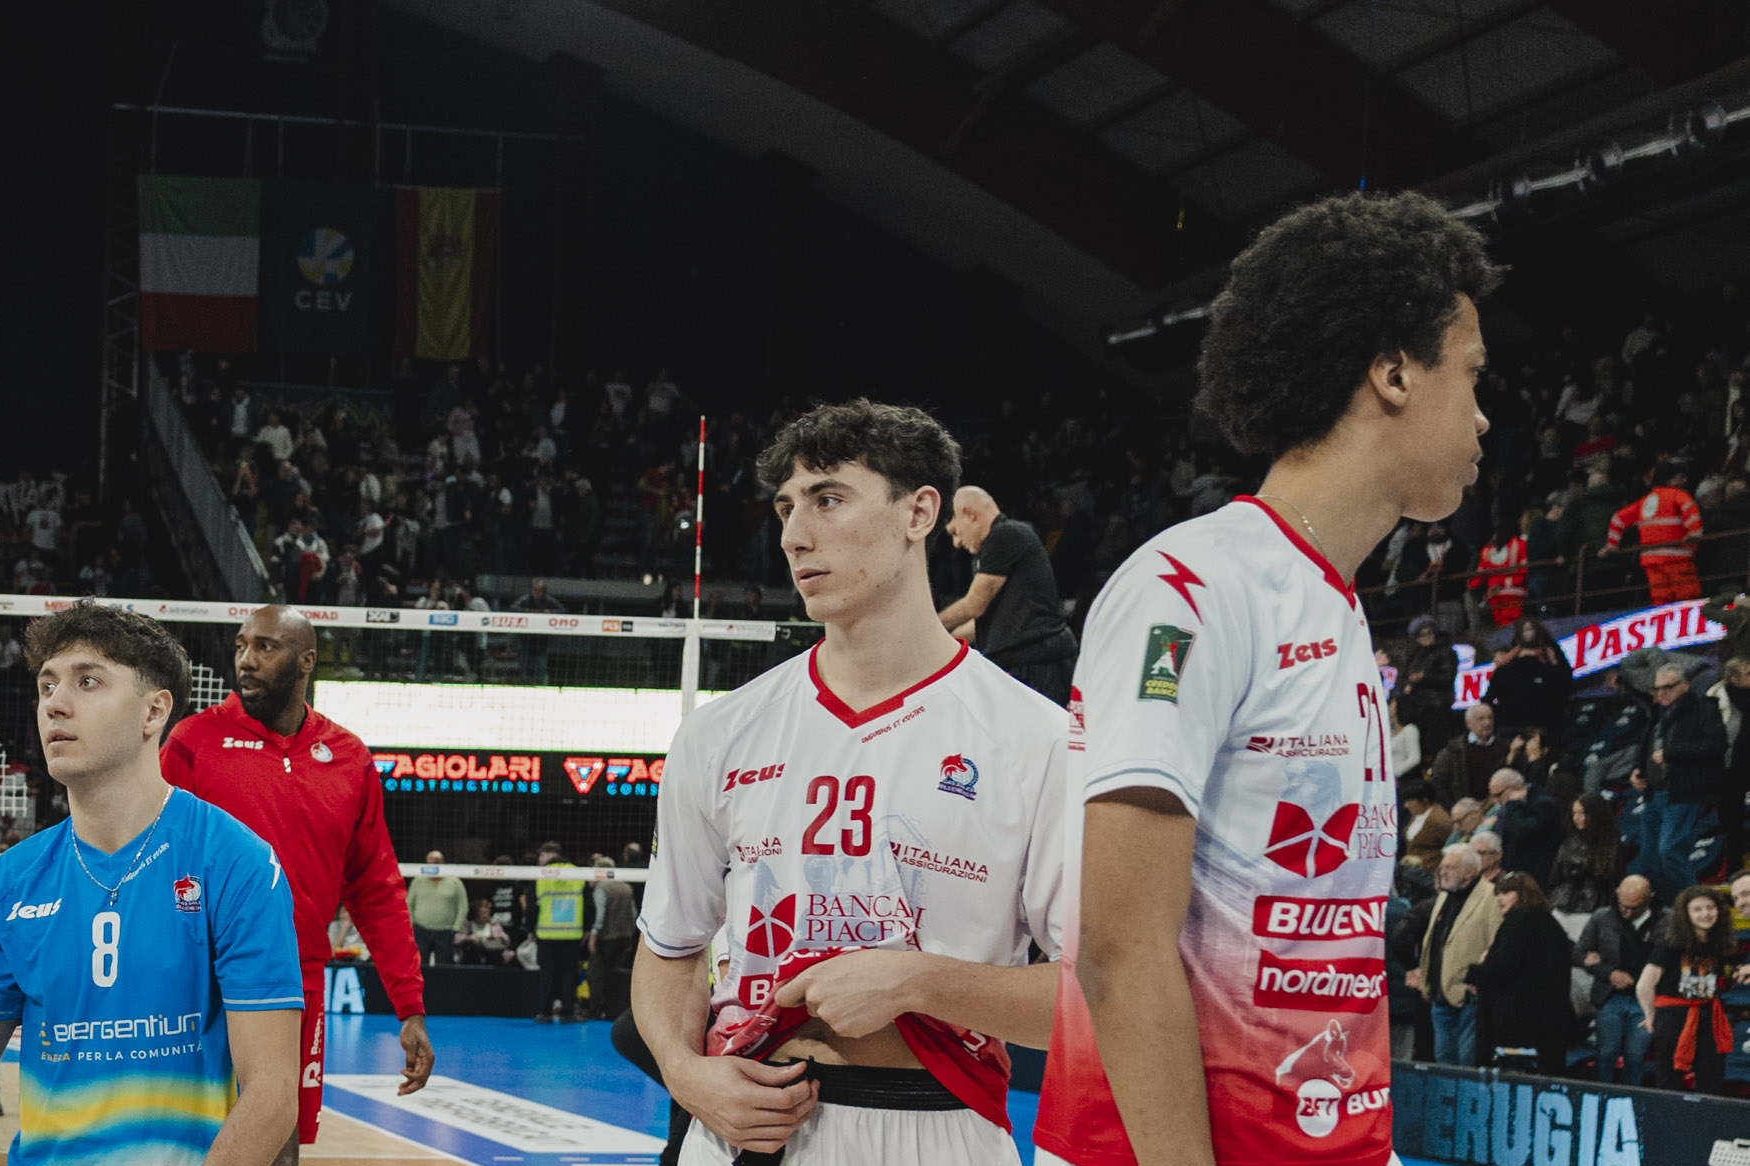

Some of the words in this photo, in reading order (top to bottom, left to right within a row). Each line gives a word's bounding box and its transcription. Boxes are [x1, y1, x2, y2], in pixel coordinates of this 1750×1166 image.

[295, 290, 353, 312] CEV
[893, 721, 900, 729] ET
[222, 736, 265, 750] Zeus
[372, 754, 541, 782] FAGIOLARI
[723, 763, 785, 793] Zeus
[801, 775, 876, 857] 23
[1357, 803, 1397, 829] BANC
[901, 856, 987, 883] ASSICURAZIONI
[903, 846, 988, 875] ITALIANA
[5, 897, 62, 922] Zeus
[806, 893, 913, 918] BANCA
[1267, 901, 1388, 936] BLUEN
[91, 912, 121, 988] 8
[78, 1051, 103, 1061] PER
[106, 1050, 124, 1061] LA
